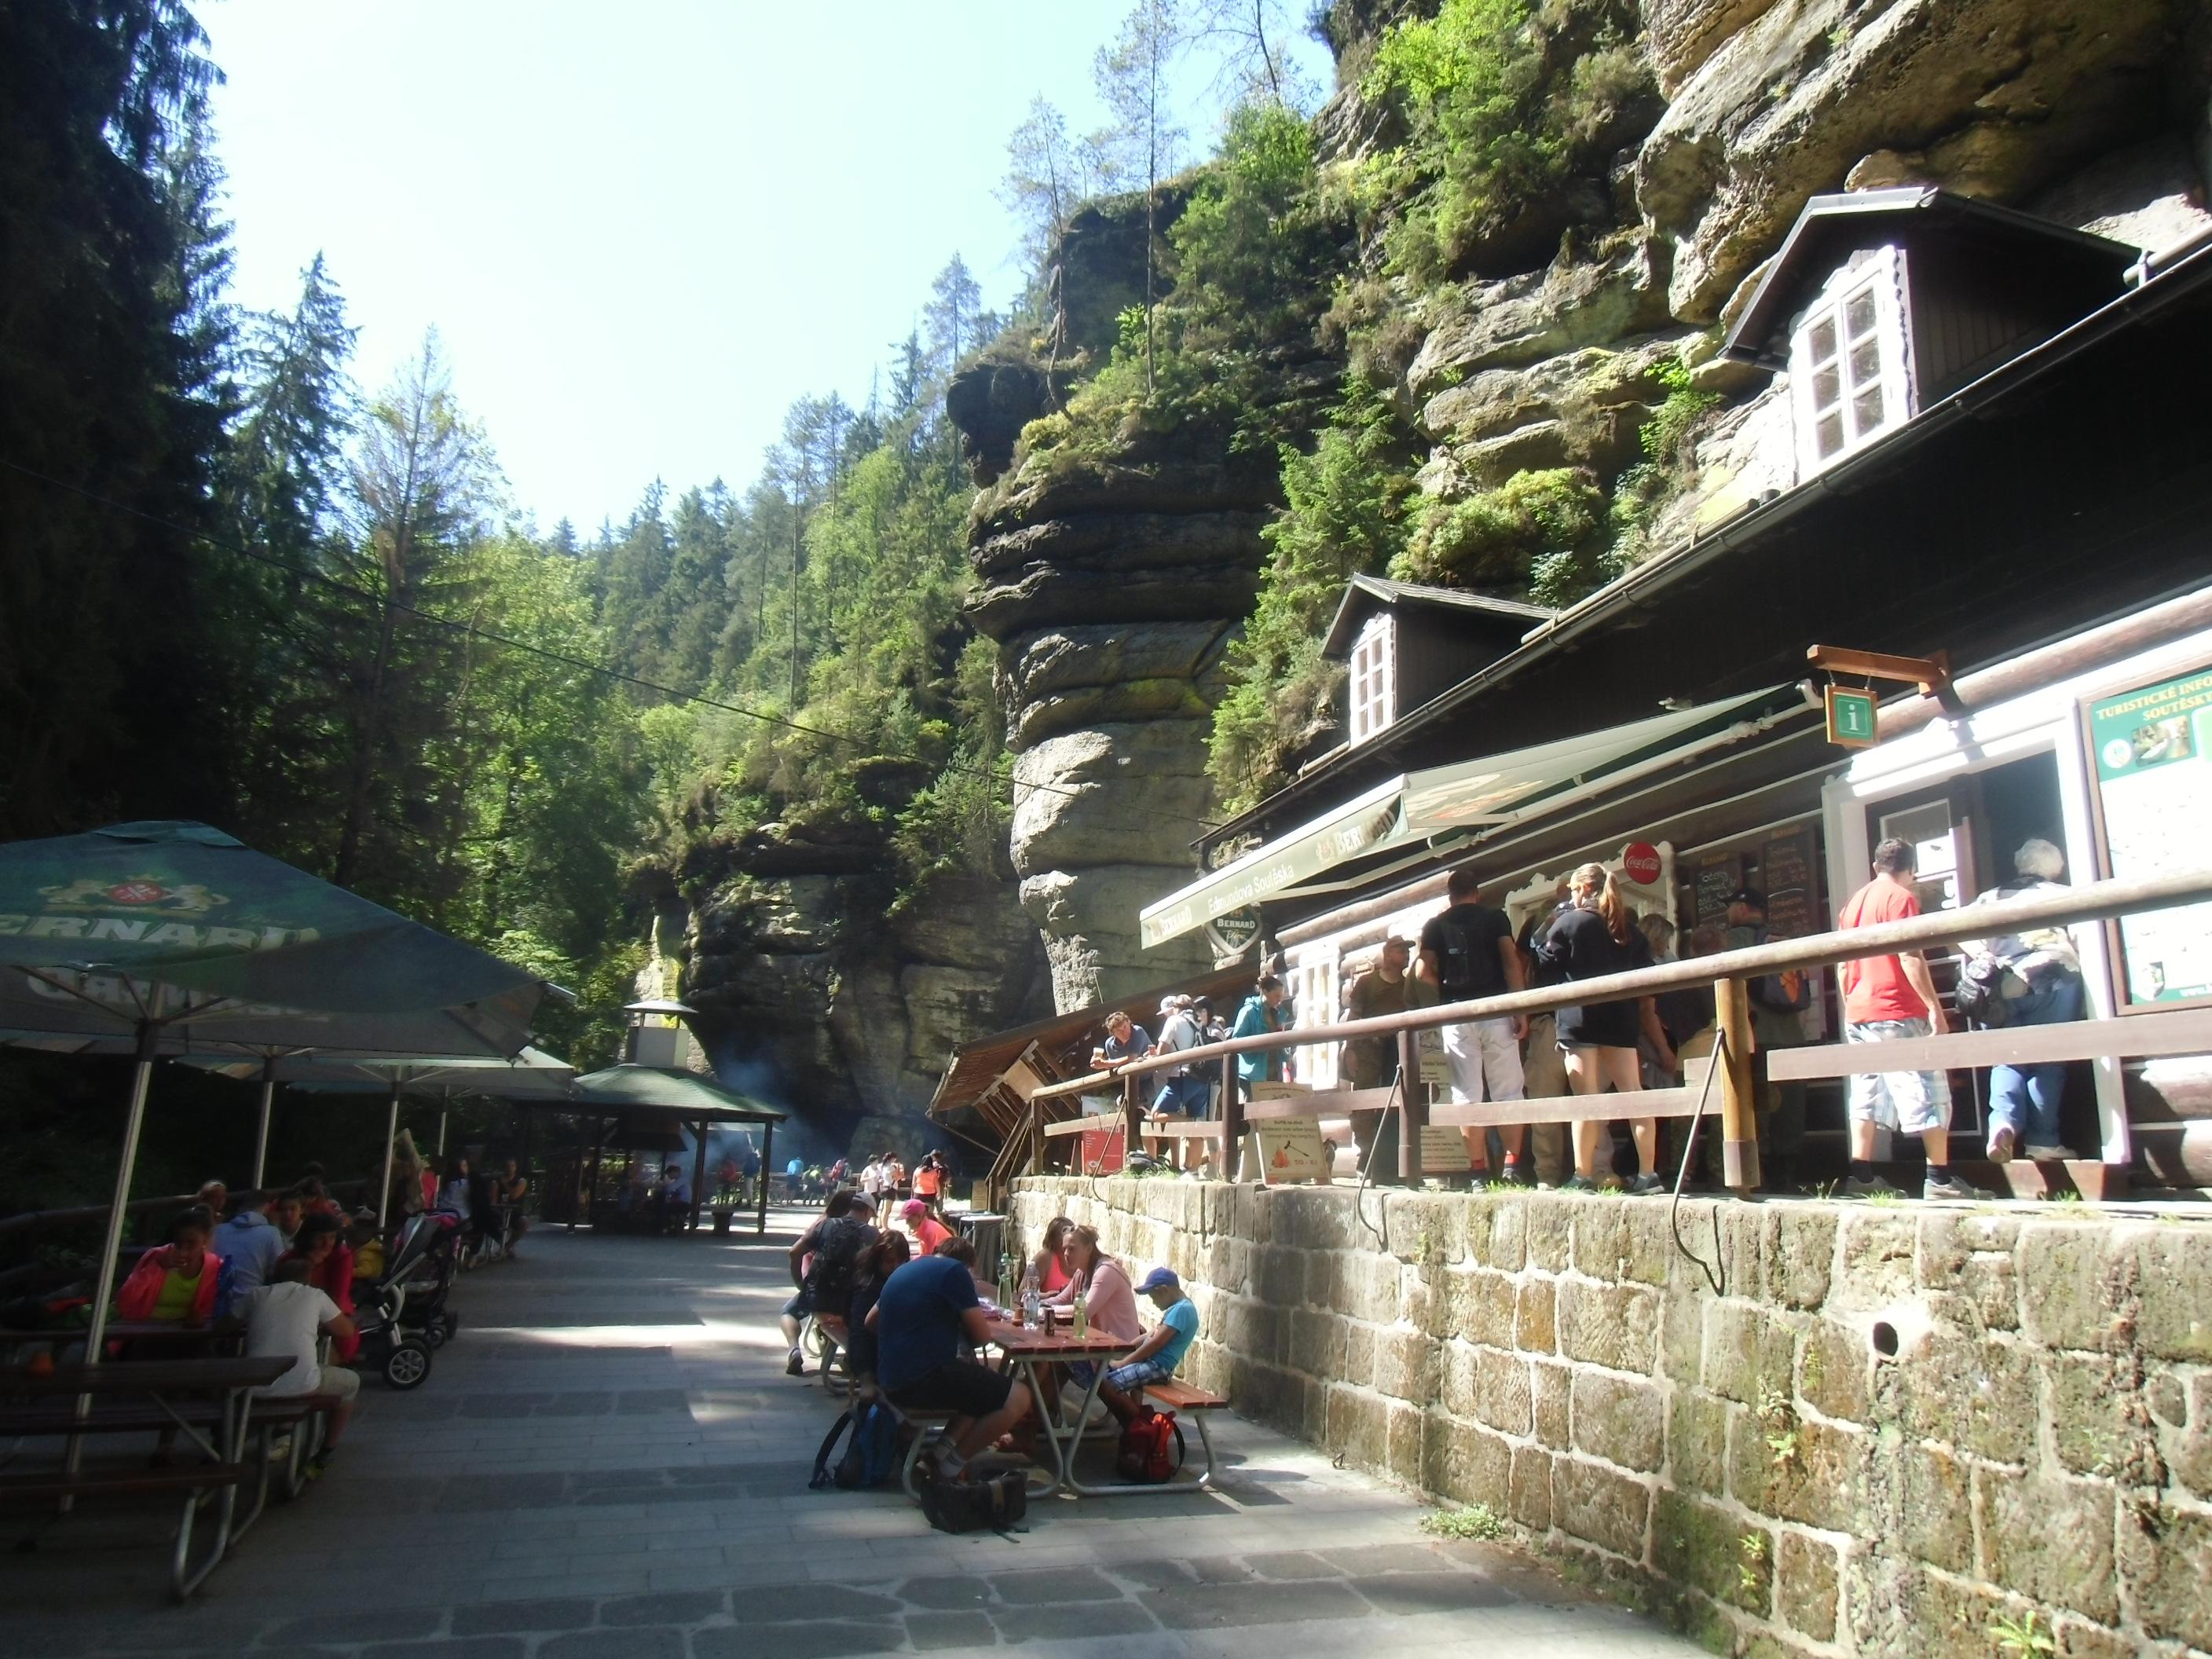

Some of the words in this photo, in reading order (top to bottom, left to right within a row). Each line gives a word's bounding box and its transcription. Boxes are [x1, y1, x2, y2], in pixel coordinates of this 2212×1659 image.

[2096, 685, 2177, 720] TURISTICKÉ
[1208, 885, 1254, 915] Edmundova
[1253, 864, 1295, 892] Soutěska
[1217, 917, 1255, 929] BERNARD
